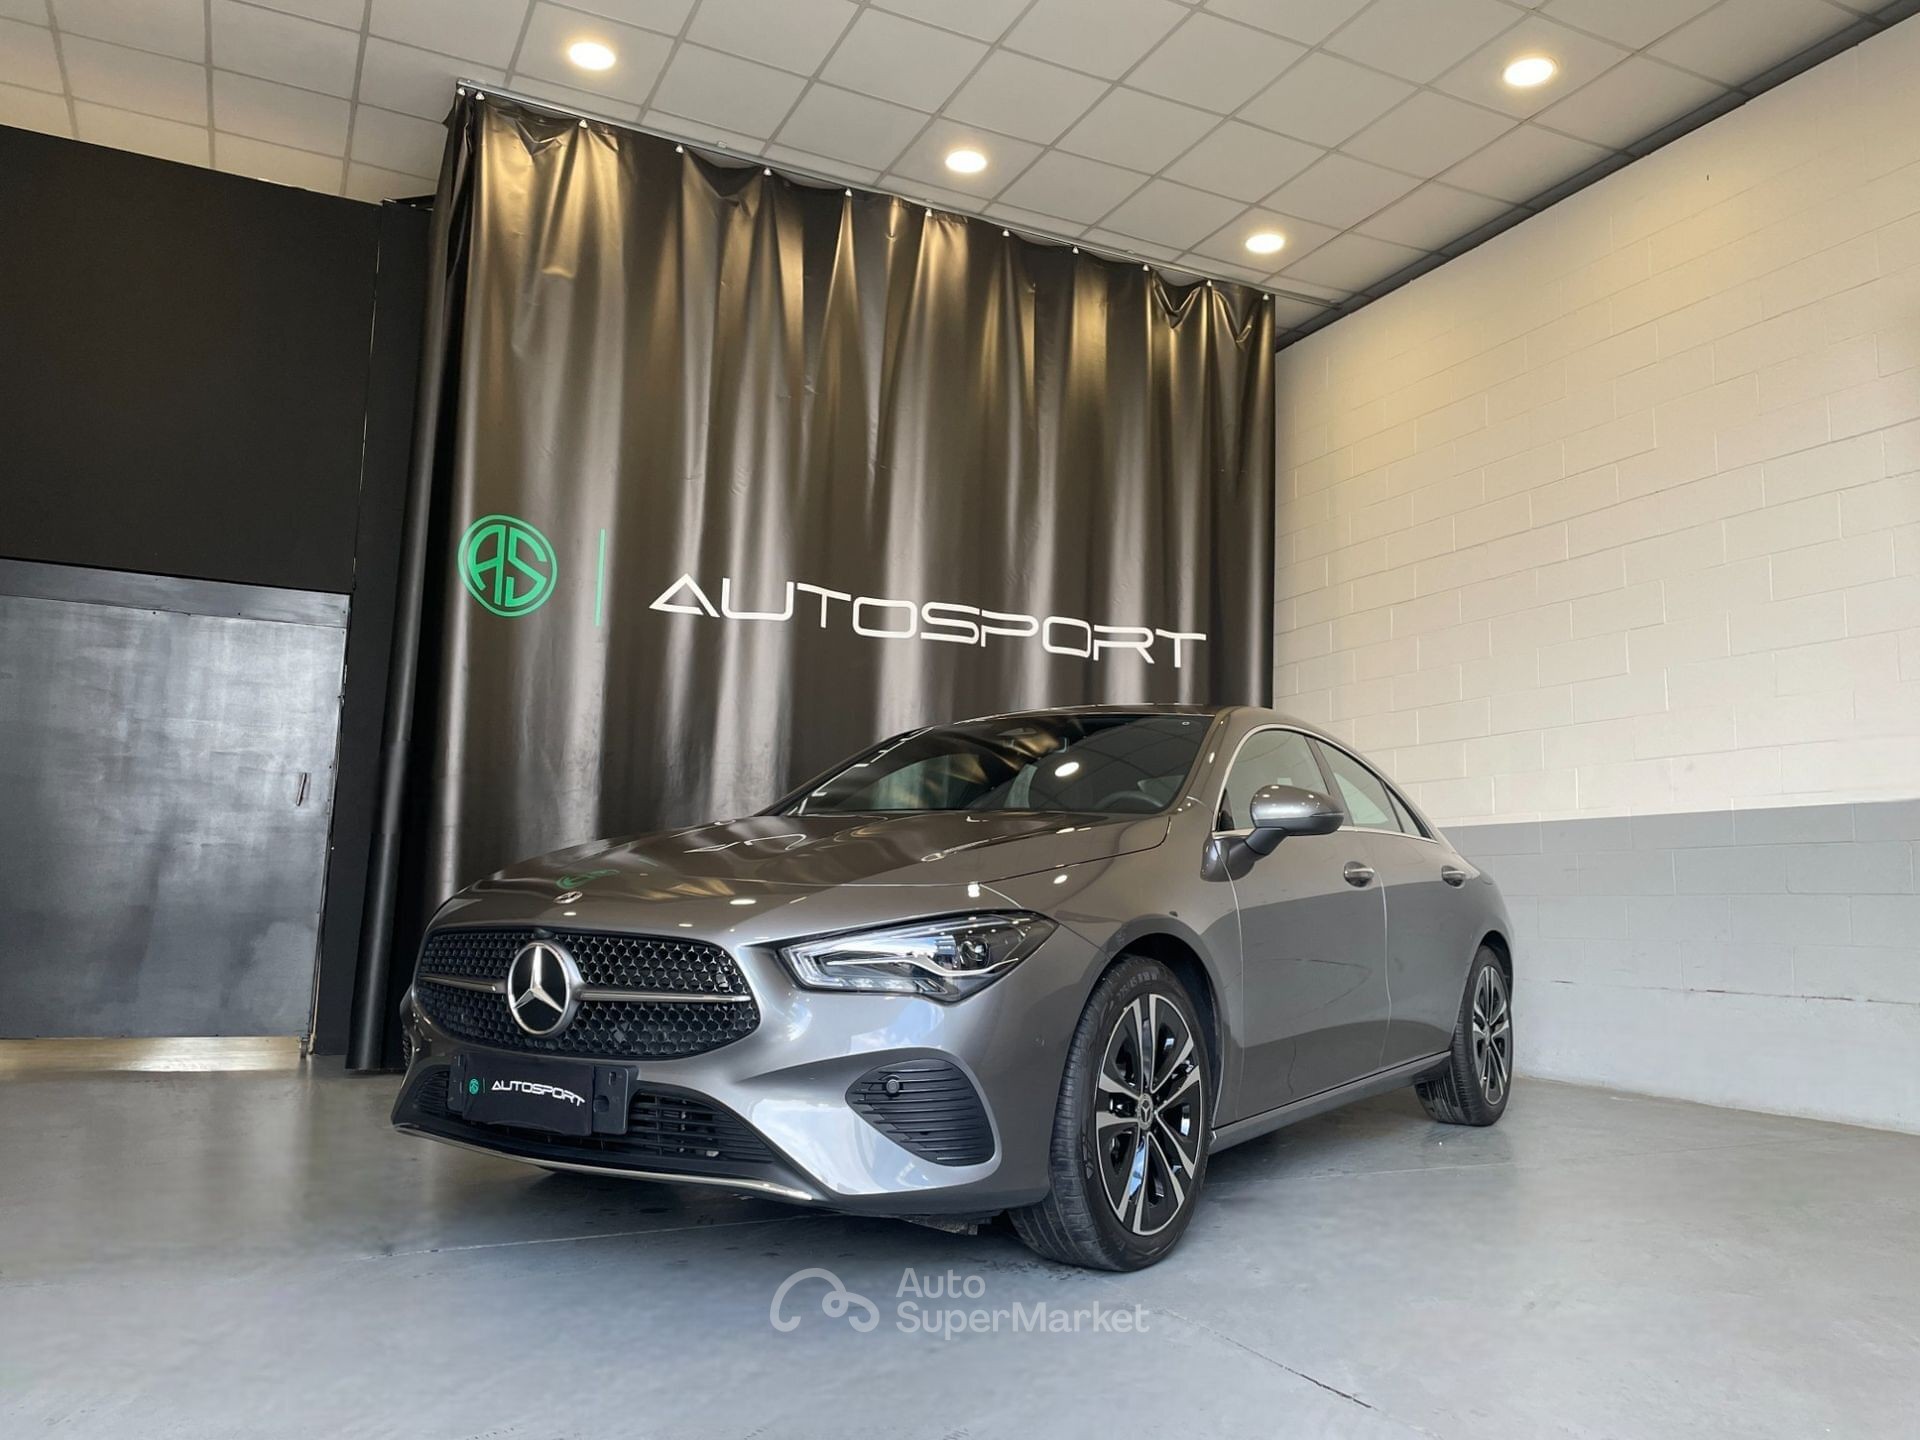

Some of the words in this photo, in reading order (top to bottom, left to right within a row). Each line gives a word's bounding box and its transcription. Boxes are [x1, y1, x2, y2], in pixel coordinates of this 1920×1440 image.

[468, 524, 547, 607] AS
[649, 572, 1207, 668] AUTOSPORT
[491, 1080, 585, 1106] AUTOSPORT
